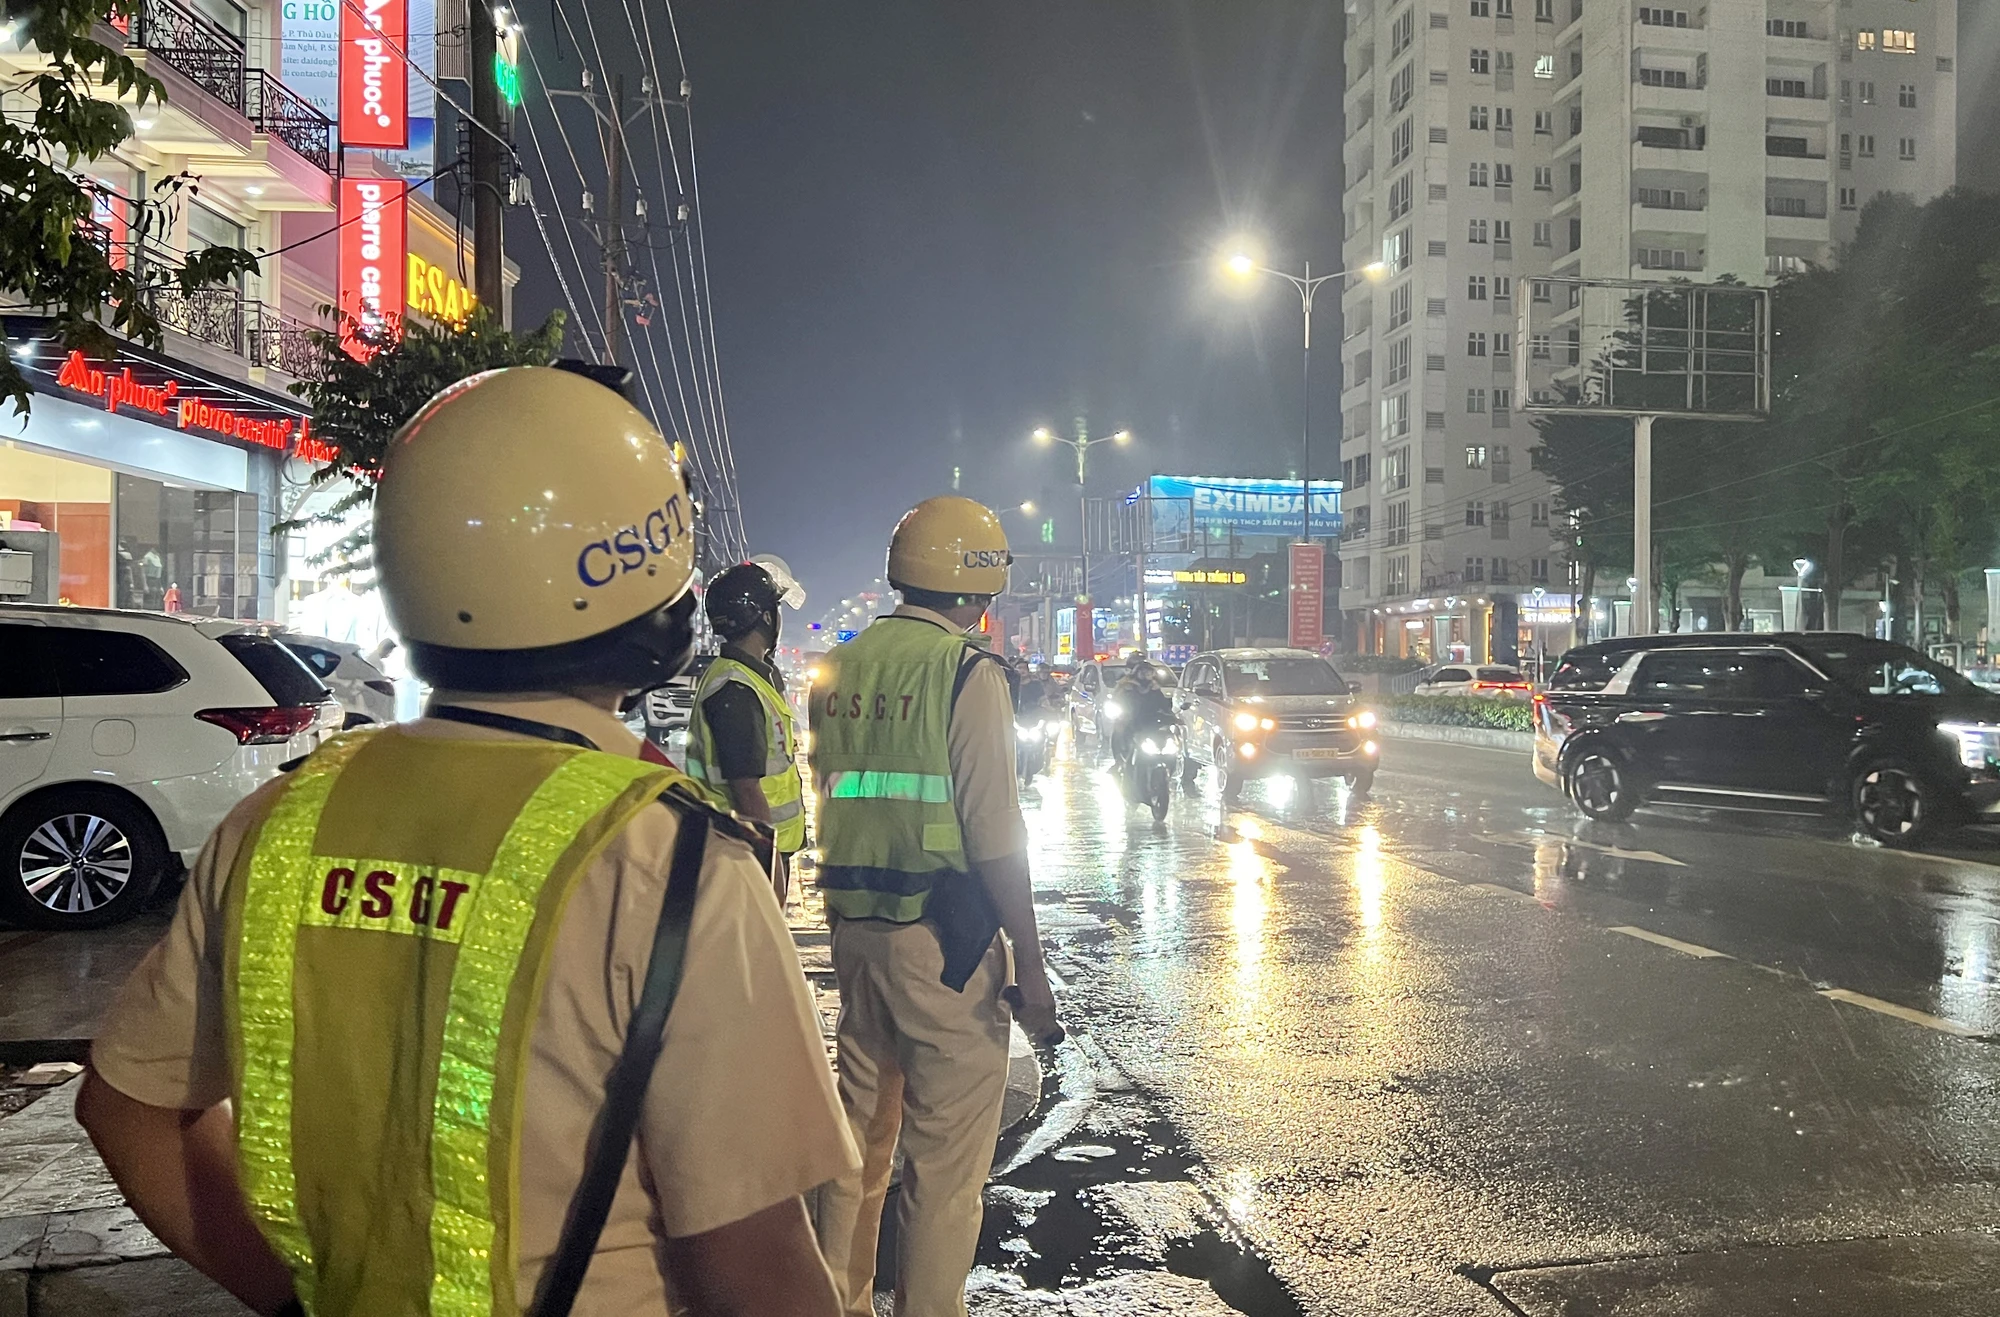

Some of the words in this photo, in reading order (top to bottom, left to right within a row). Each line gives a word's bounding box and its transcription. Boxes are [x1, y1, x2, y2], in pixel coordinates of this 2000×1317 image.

[291, 70, 338, 78] contact@da
[301, 57, 338, 67] daidongh
[357, 184, 381, 261] pierre
[177, 396, 234, 434] pierre
[1240, 518, 1260, 526] TMCP
[577, 493, 685, 588] CSGT
